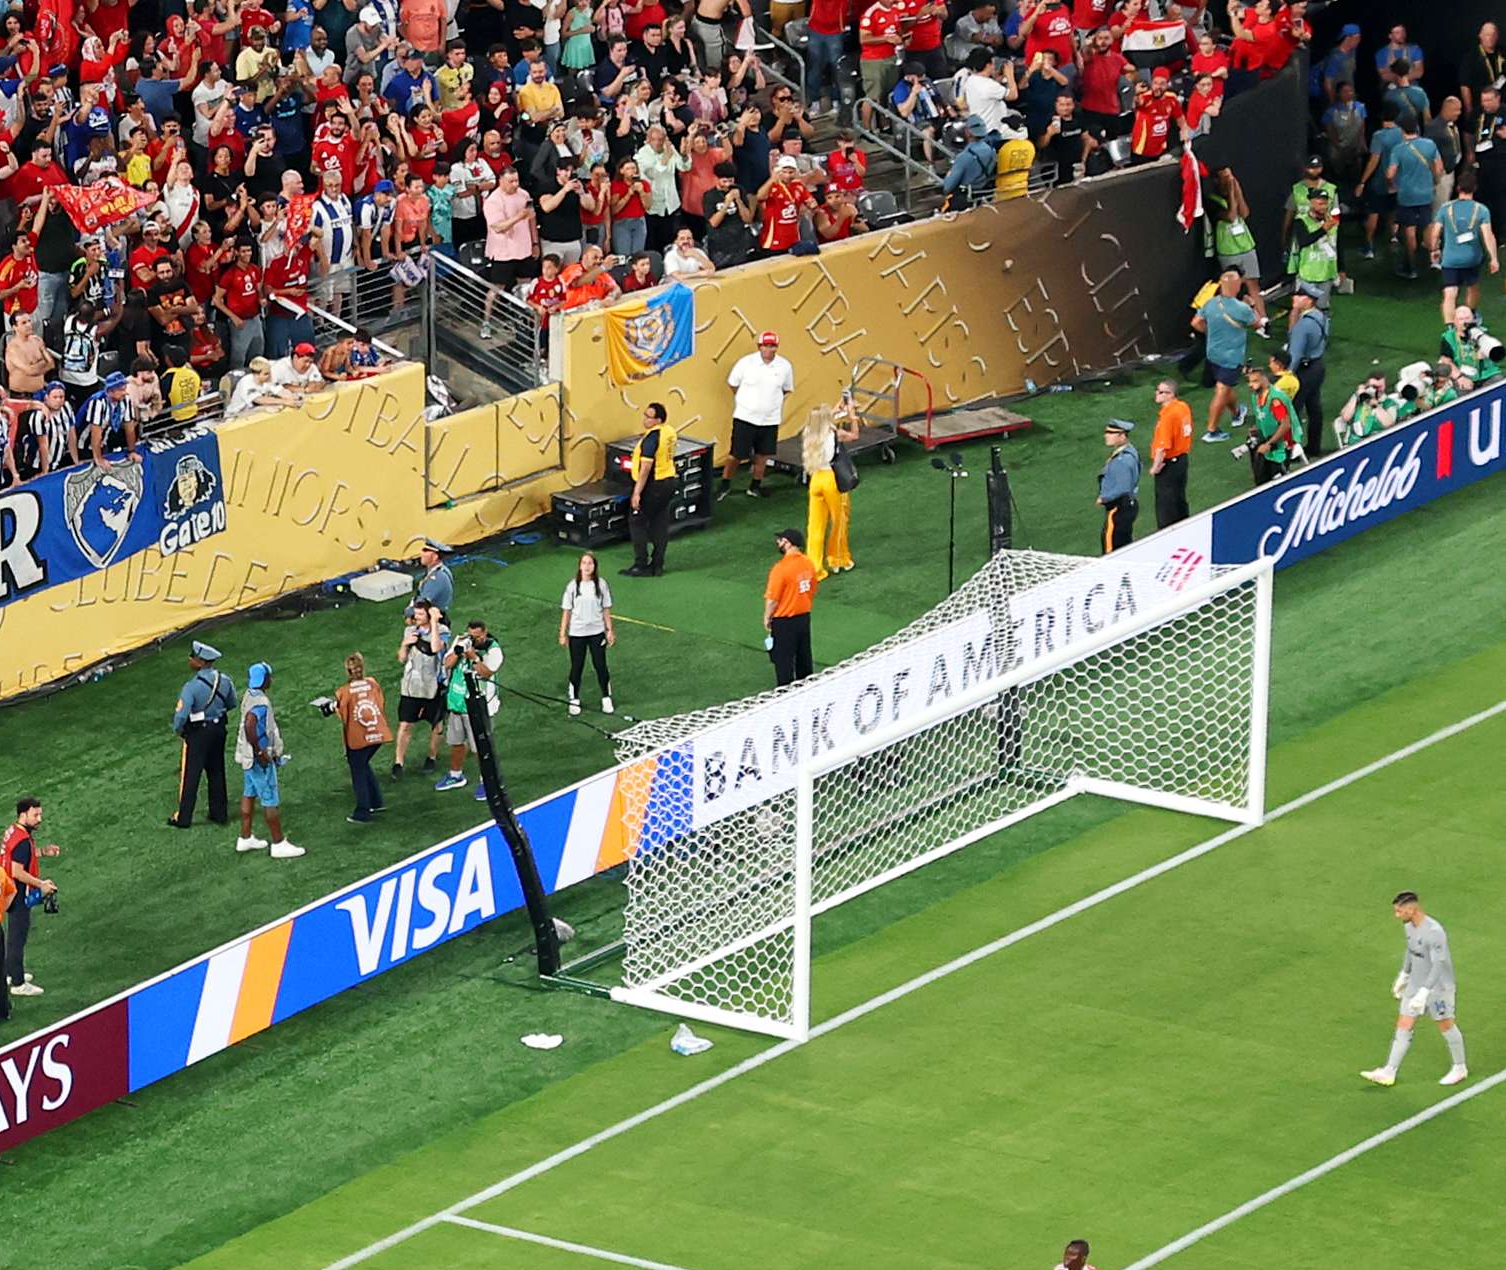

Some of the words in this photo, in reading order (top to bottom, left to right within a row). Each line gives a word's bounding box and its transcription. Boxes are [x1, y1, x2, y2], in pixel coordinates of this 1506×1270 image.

[160, 511, 212, 556] Gate
[211, 500, 225, 532] 10
[1258, 431, 1428, 563] Michelob
[1469, 398, 1501, 466] U
[703, 701, 838, 804] BANK
[853, 667, 912, 737] OF
[925, 571, 1139, 706] AMERICA
[334, 837, 496, 977] VISA
